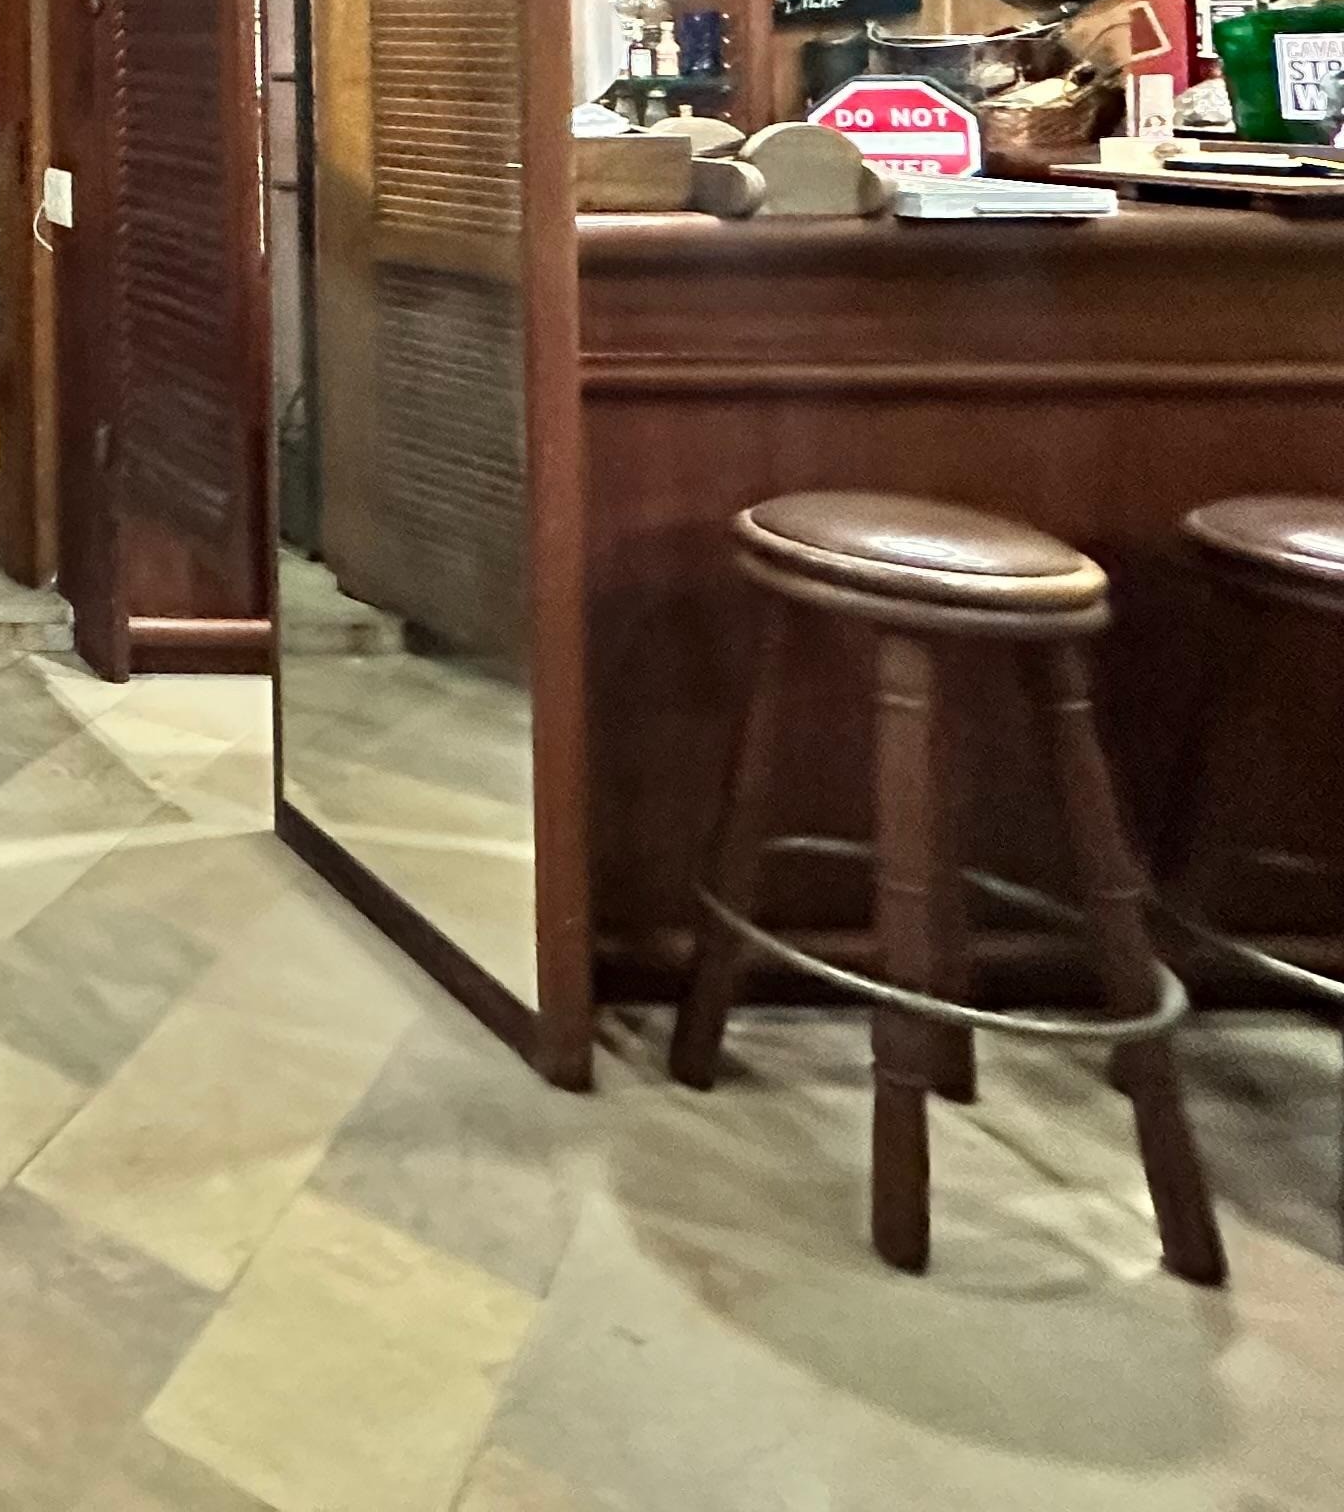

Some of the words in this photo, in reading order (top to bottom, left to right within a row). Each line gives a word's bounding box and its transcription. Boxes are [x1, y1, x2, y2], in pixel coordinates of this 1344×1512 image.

[1286, 41, 1344, 58] CAVA
[834, 108, 874, 128] DO
[890, 108, 950, 127] NOT
[872, 160, 943, 175] TER
